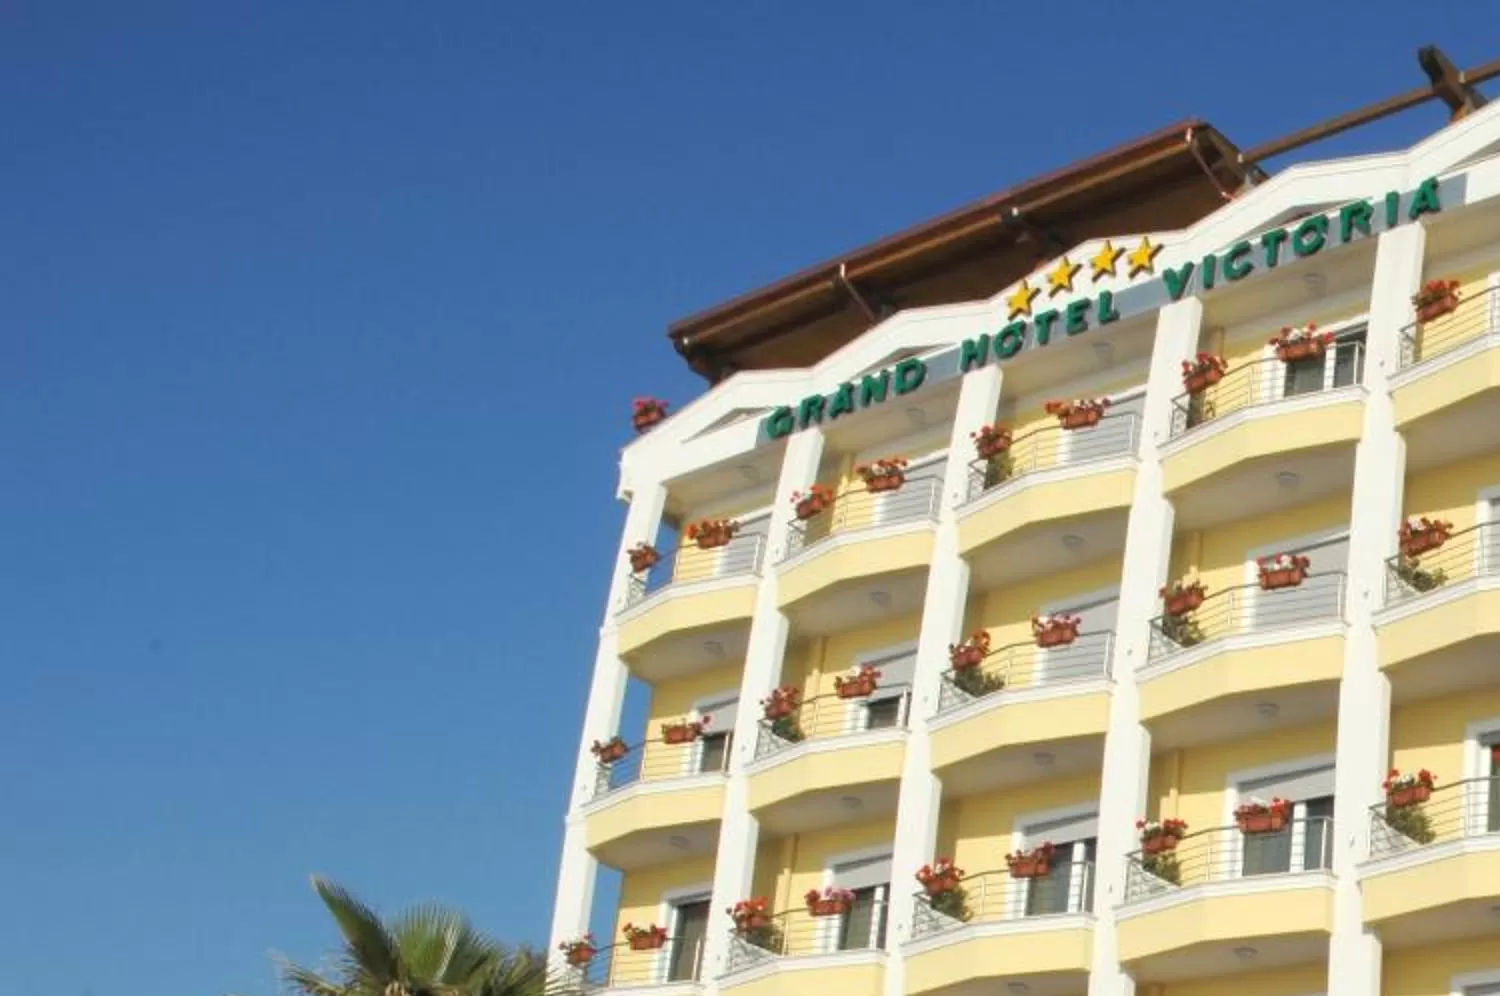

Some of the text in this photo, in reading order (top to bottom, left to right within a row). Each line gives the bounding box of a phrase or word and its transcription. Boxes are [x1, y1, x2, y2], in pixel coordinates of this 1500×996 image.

[767, 176, 1441, 440] GRAND HOTEL VICTORIA
